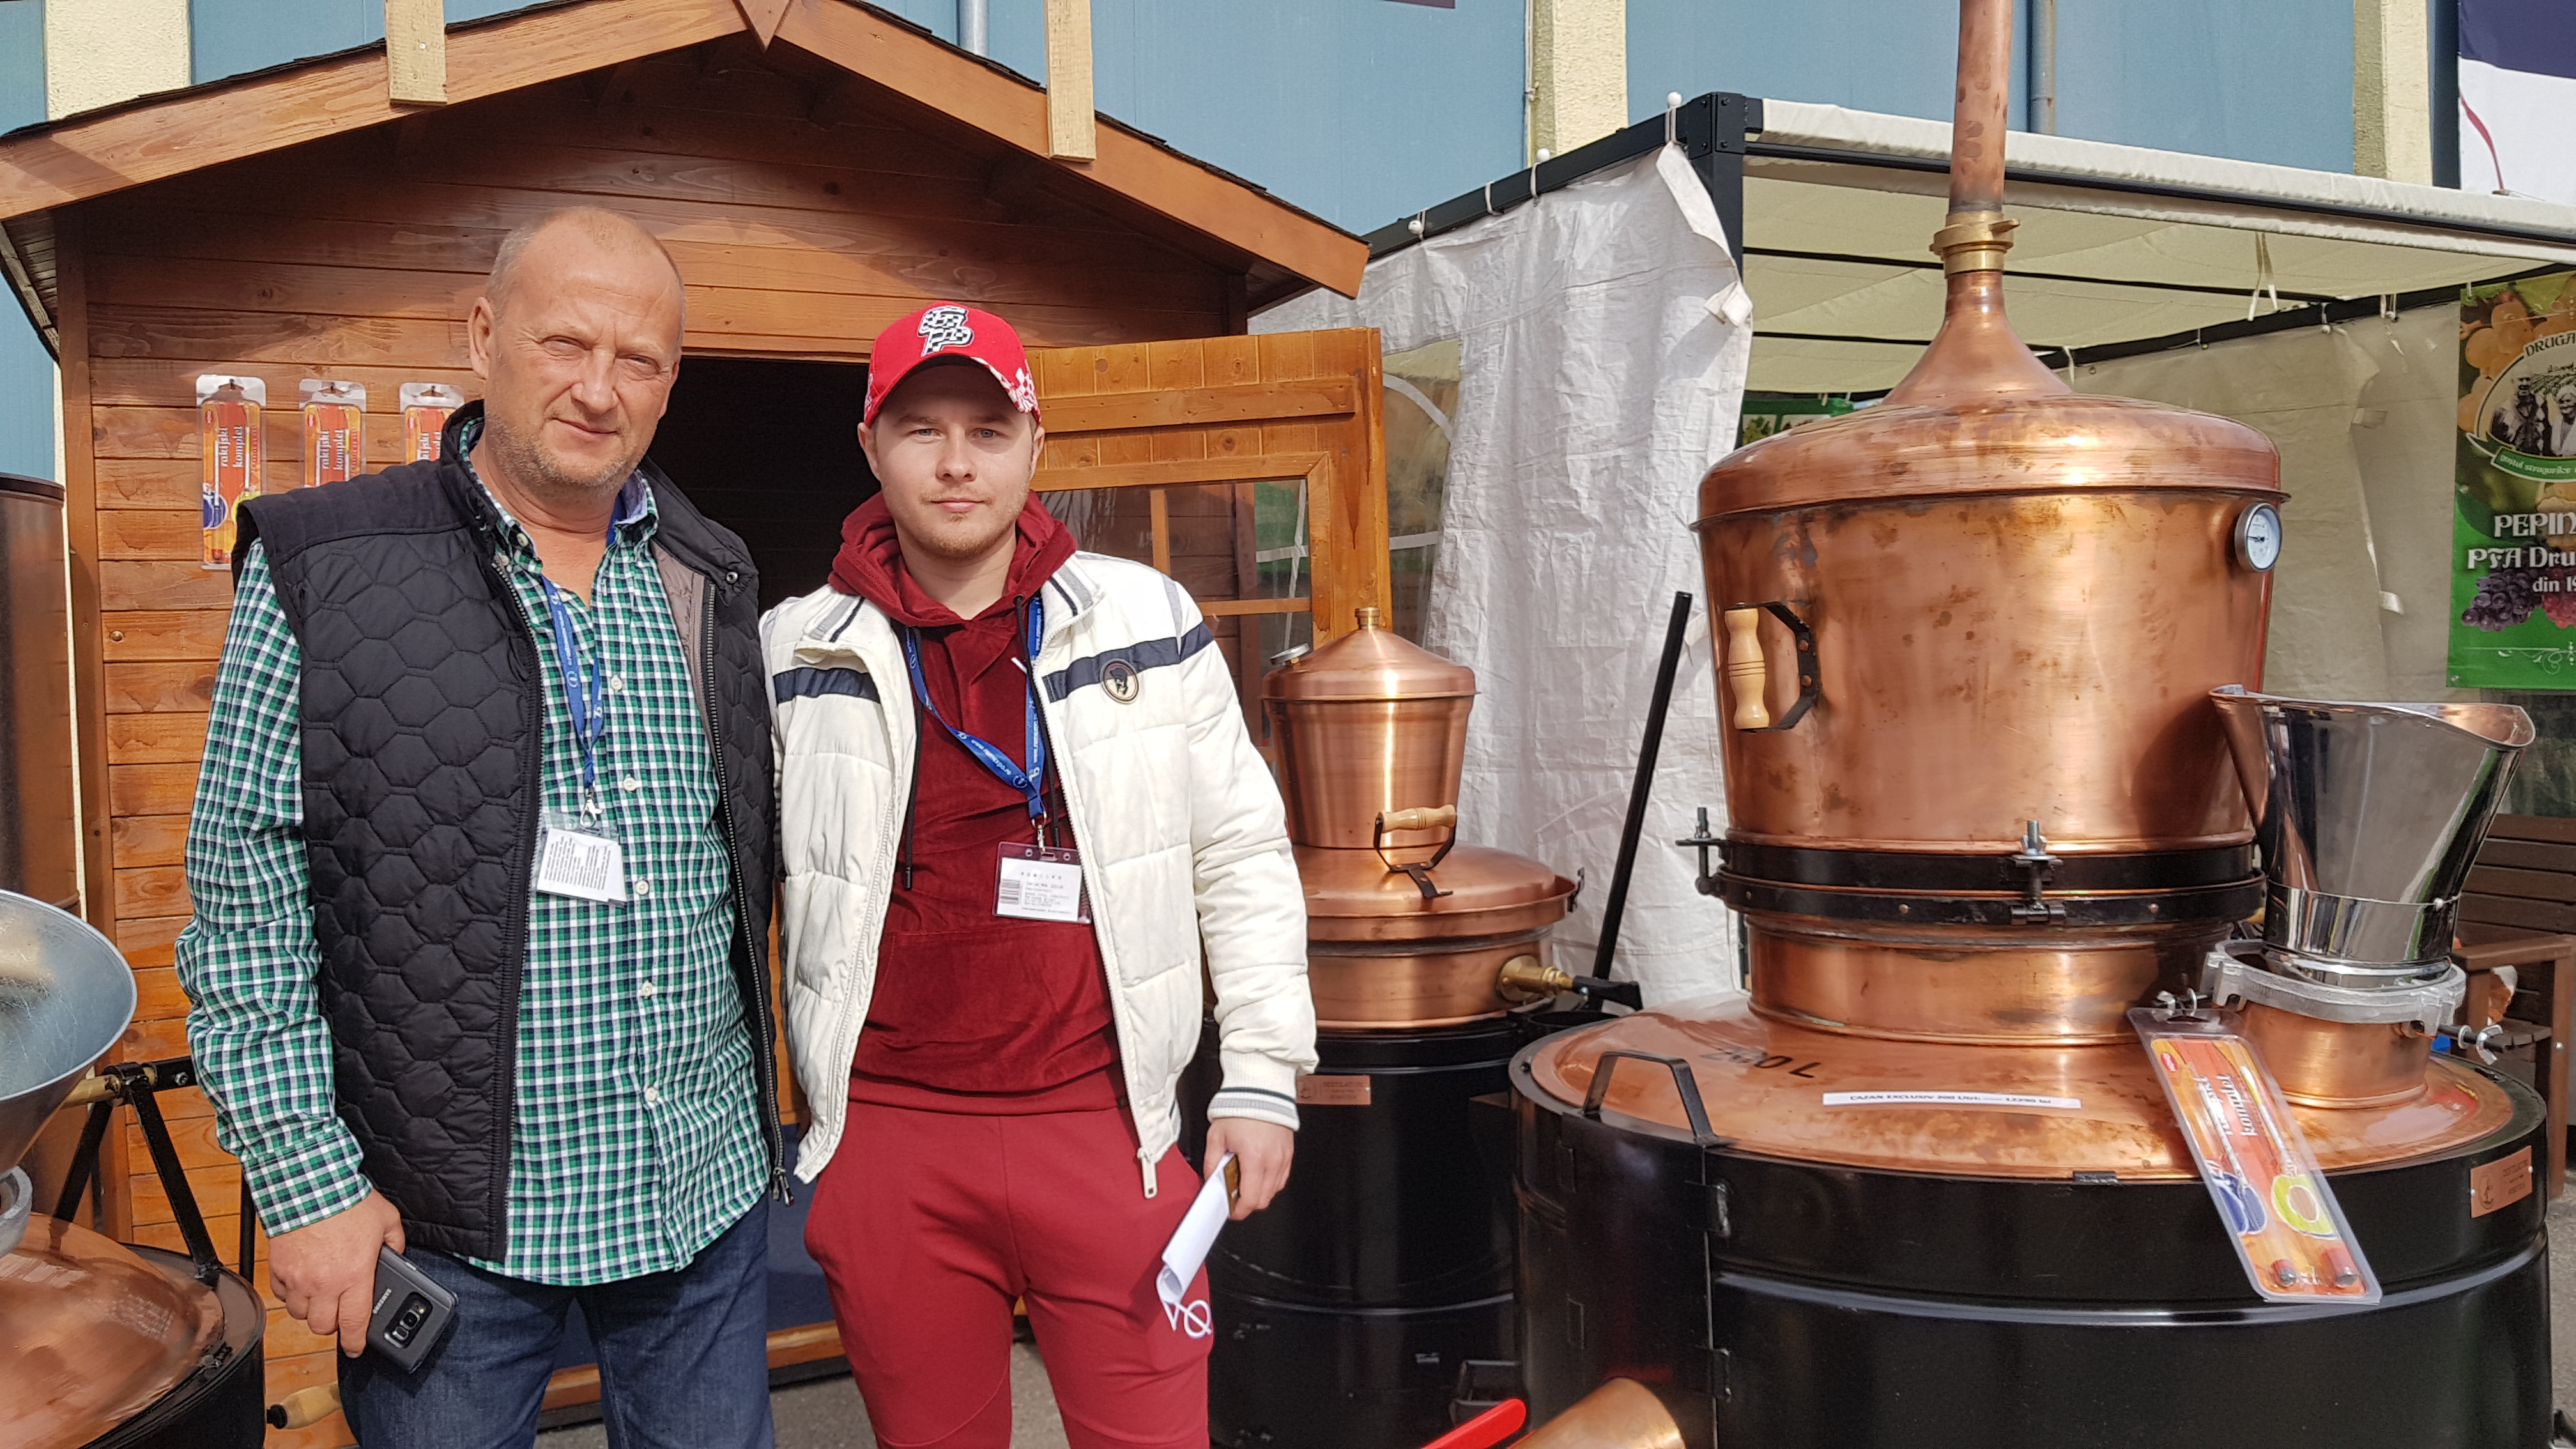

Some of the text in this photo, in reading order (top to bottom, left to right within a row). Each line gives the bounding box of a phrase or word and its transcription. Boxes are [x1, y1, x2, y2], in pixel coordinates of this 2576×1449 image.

[218, 427, 231, 467] rakijski
[232, 425, 245, 468] komplet
[333, 429, 346, 470] komplet
[2532, 576, 2560, 593] din
[372, 1288, 392, 1314] SAMSUNG
